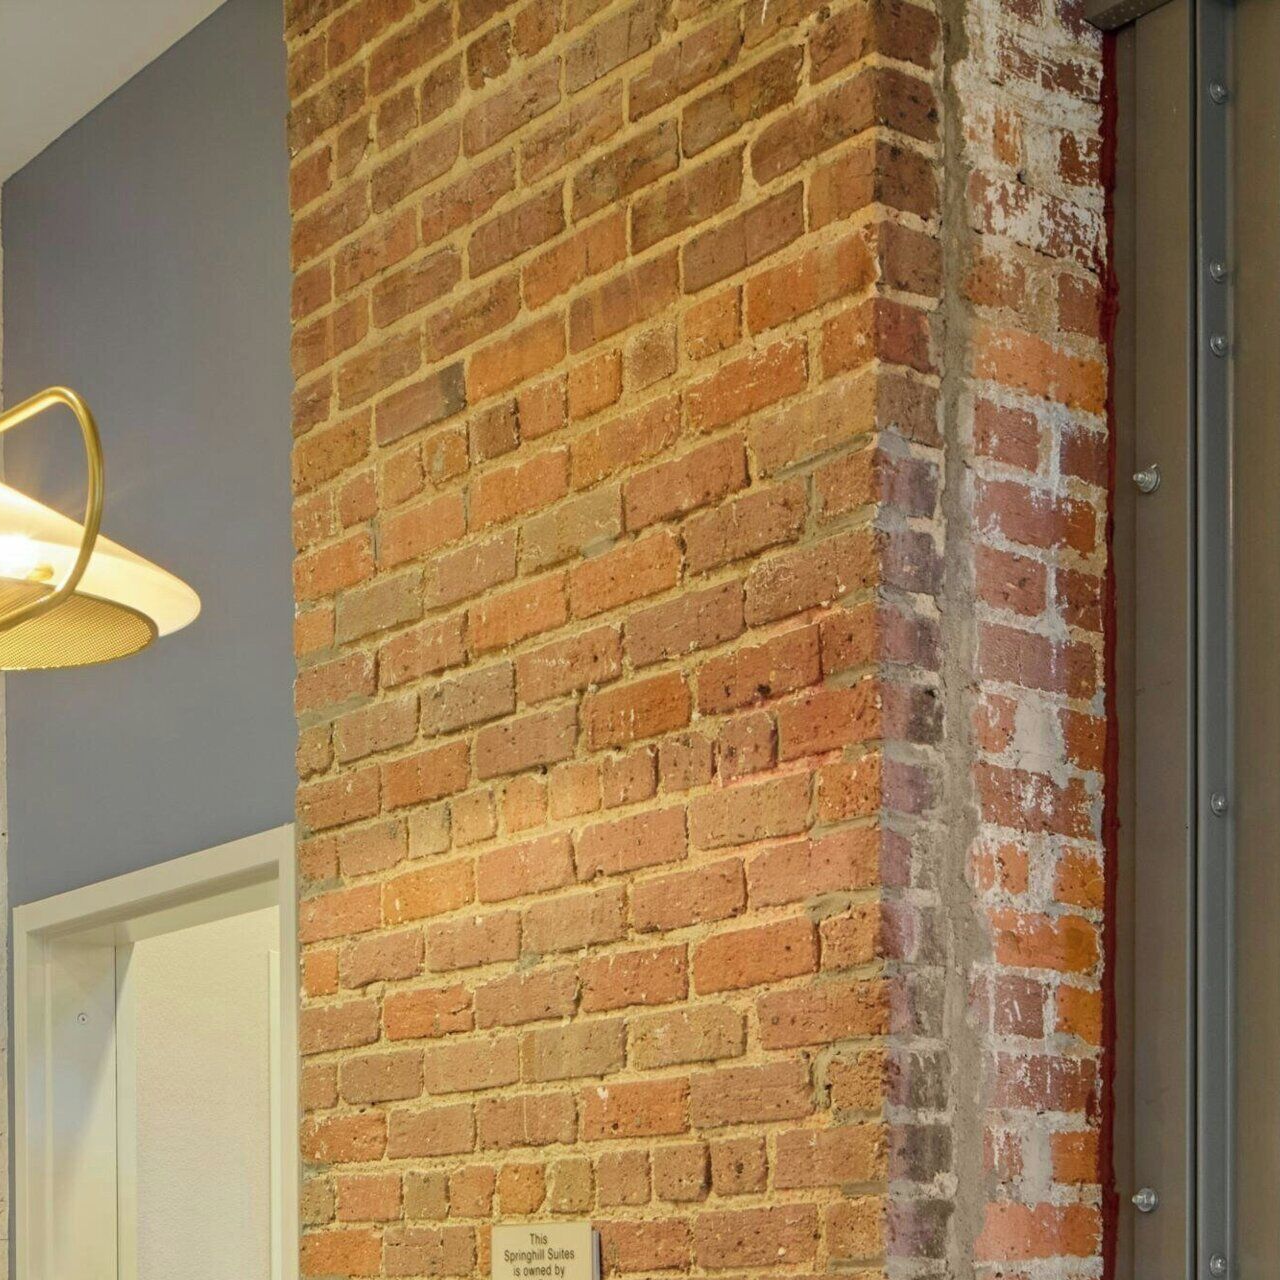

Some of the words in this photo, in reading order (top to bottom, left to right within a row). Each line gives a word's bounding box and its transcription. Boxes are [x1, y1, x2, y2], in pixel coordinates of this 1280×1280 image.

[530, 1233, 548, 1245] This
[504, 1249, 545, 1264] Springhill
[547, 1247, 575, 1260] Suites
[513, 1265, 521, 1277] is
[523, 1264, 552, 1277] owned
[554, 1263, 565, 1278] by
